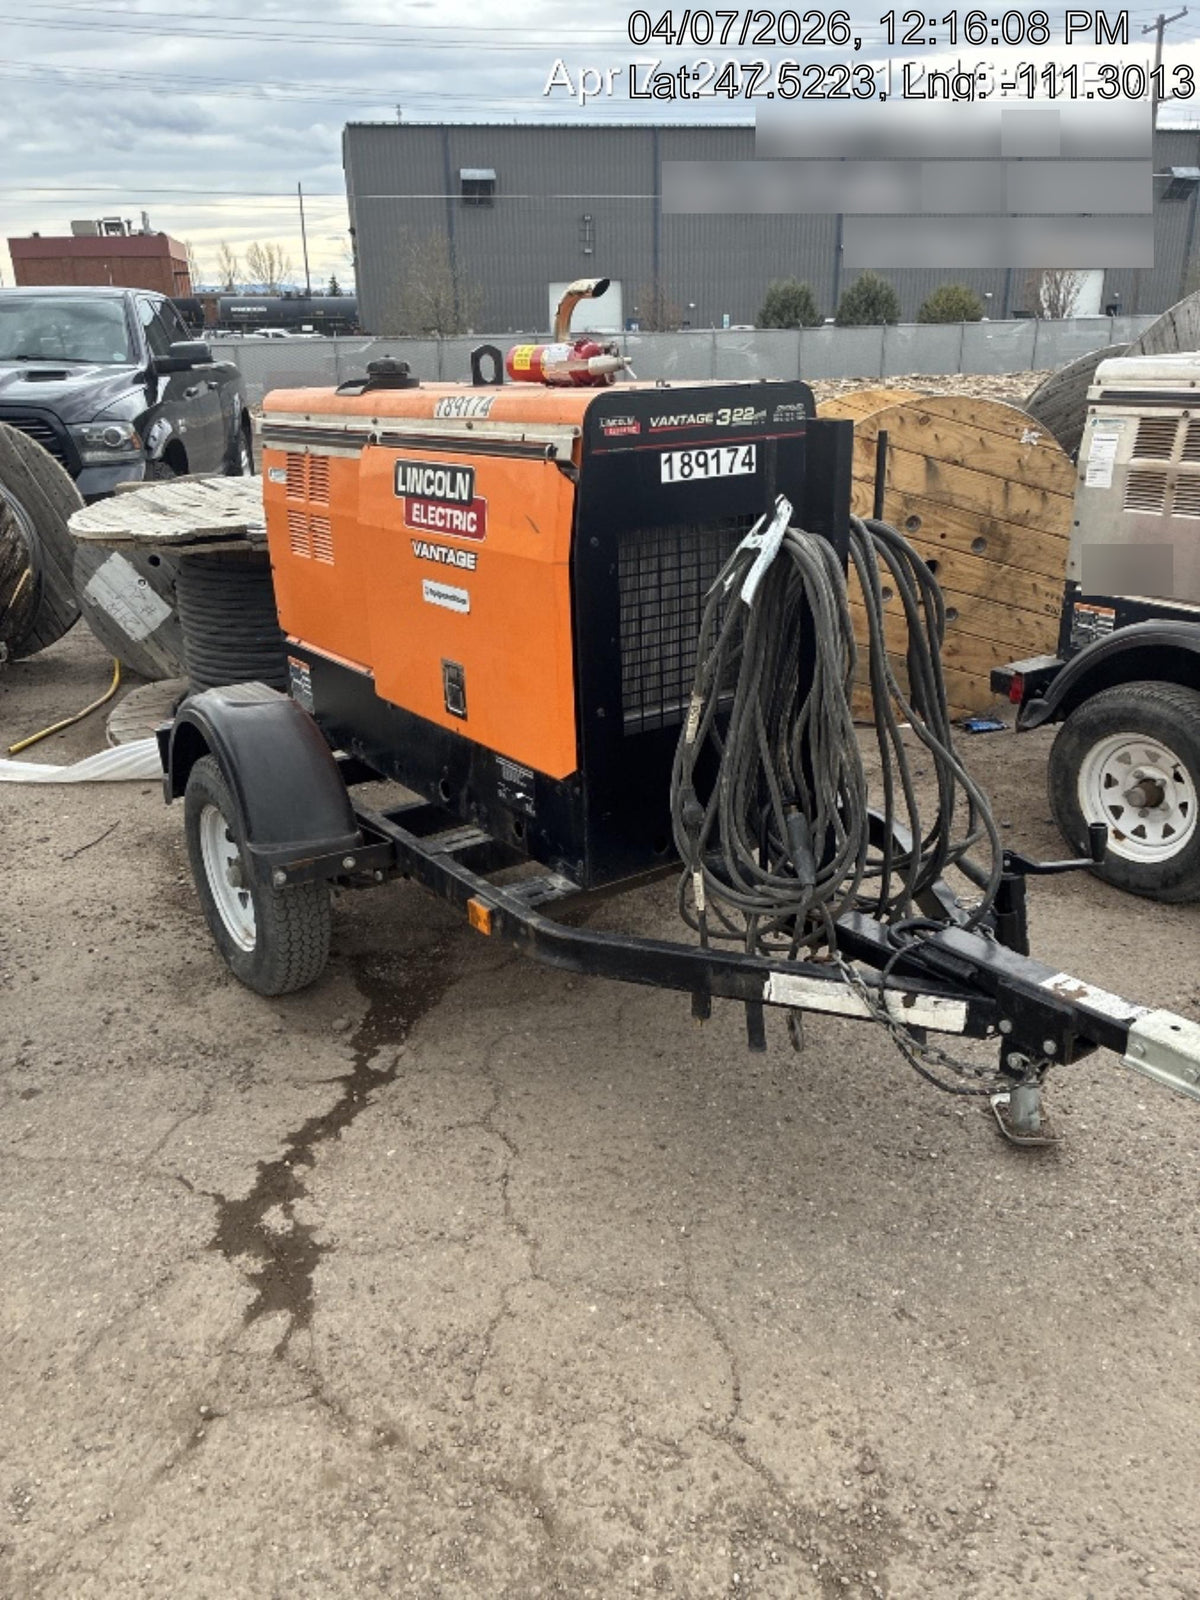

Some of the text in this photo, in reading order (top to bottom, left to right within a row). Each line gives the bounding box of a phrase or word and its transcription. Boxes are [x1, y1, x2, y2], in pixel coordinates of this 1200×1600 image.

[649, 412, 714, 428] VANTAGE
[663, 445, 755, 480] 189174
[397, 464, 470, 501] LINCOLN
[411, 502, 478, 533] ELECTRIC
[411, 539, 478, 570] VANTAGE
